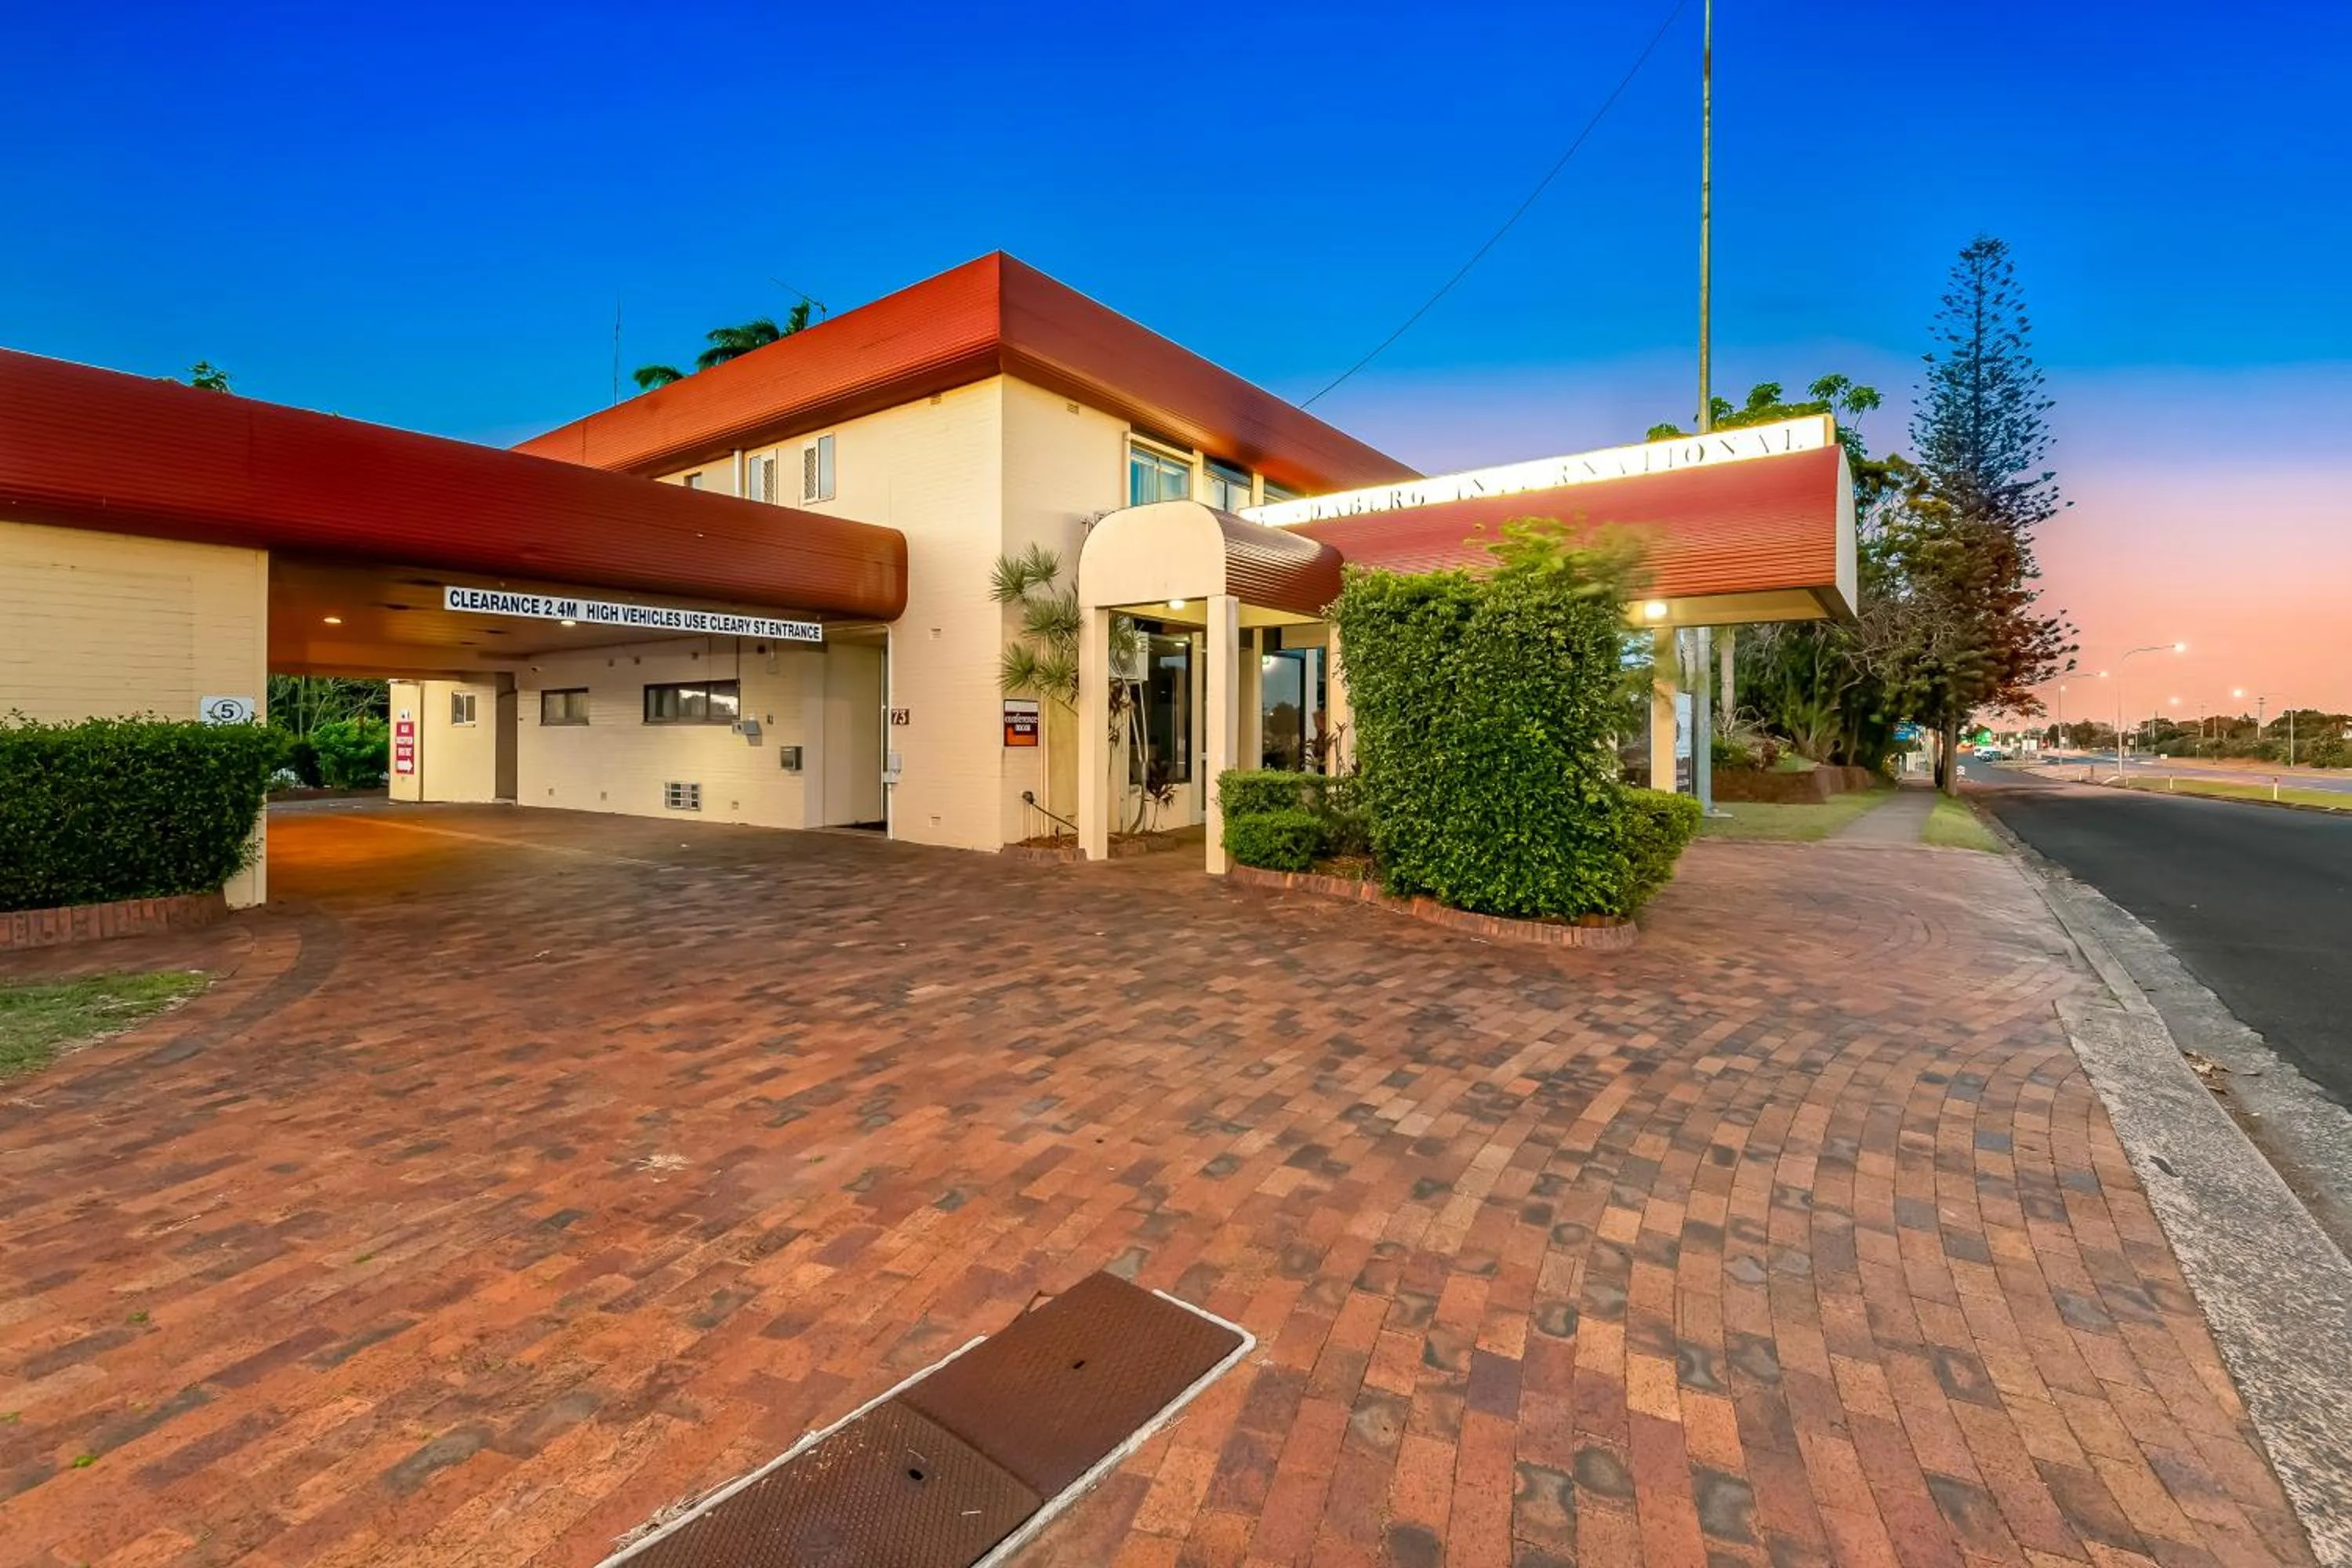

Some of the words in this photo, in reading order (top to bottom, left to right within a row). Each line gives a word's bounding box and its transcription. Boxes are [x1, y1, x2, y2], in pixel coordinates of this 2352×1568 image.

[450, 590, 540, 614] CLEARANCE
[544, 600, 577, 618] 2.4M
[587, 604, 619, 622] HIGH
[622, 608, 681, 626] VEHICLES
[684, 613, 706, 628] USE
[710, 616, 750, 632] CLEARY
[769, 622, 819, 639] ENTRANCE
[221, 704, 234, 718] 5
[892, 710, 906, 725] 73
